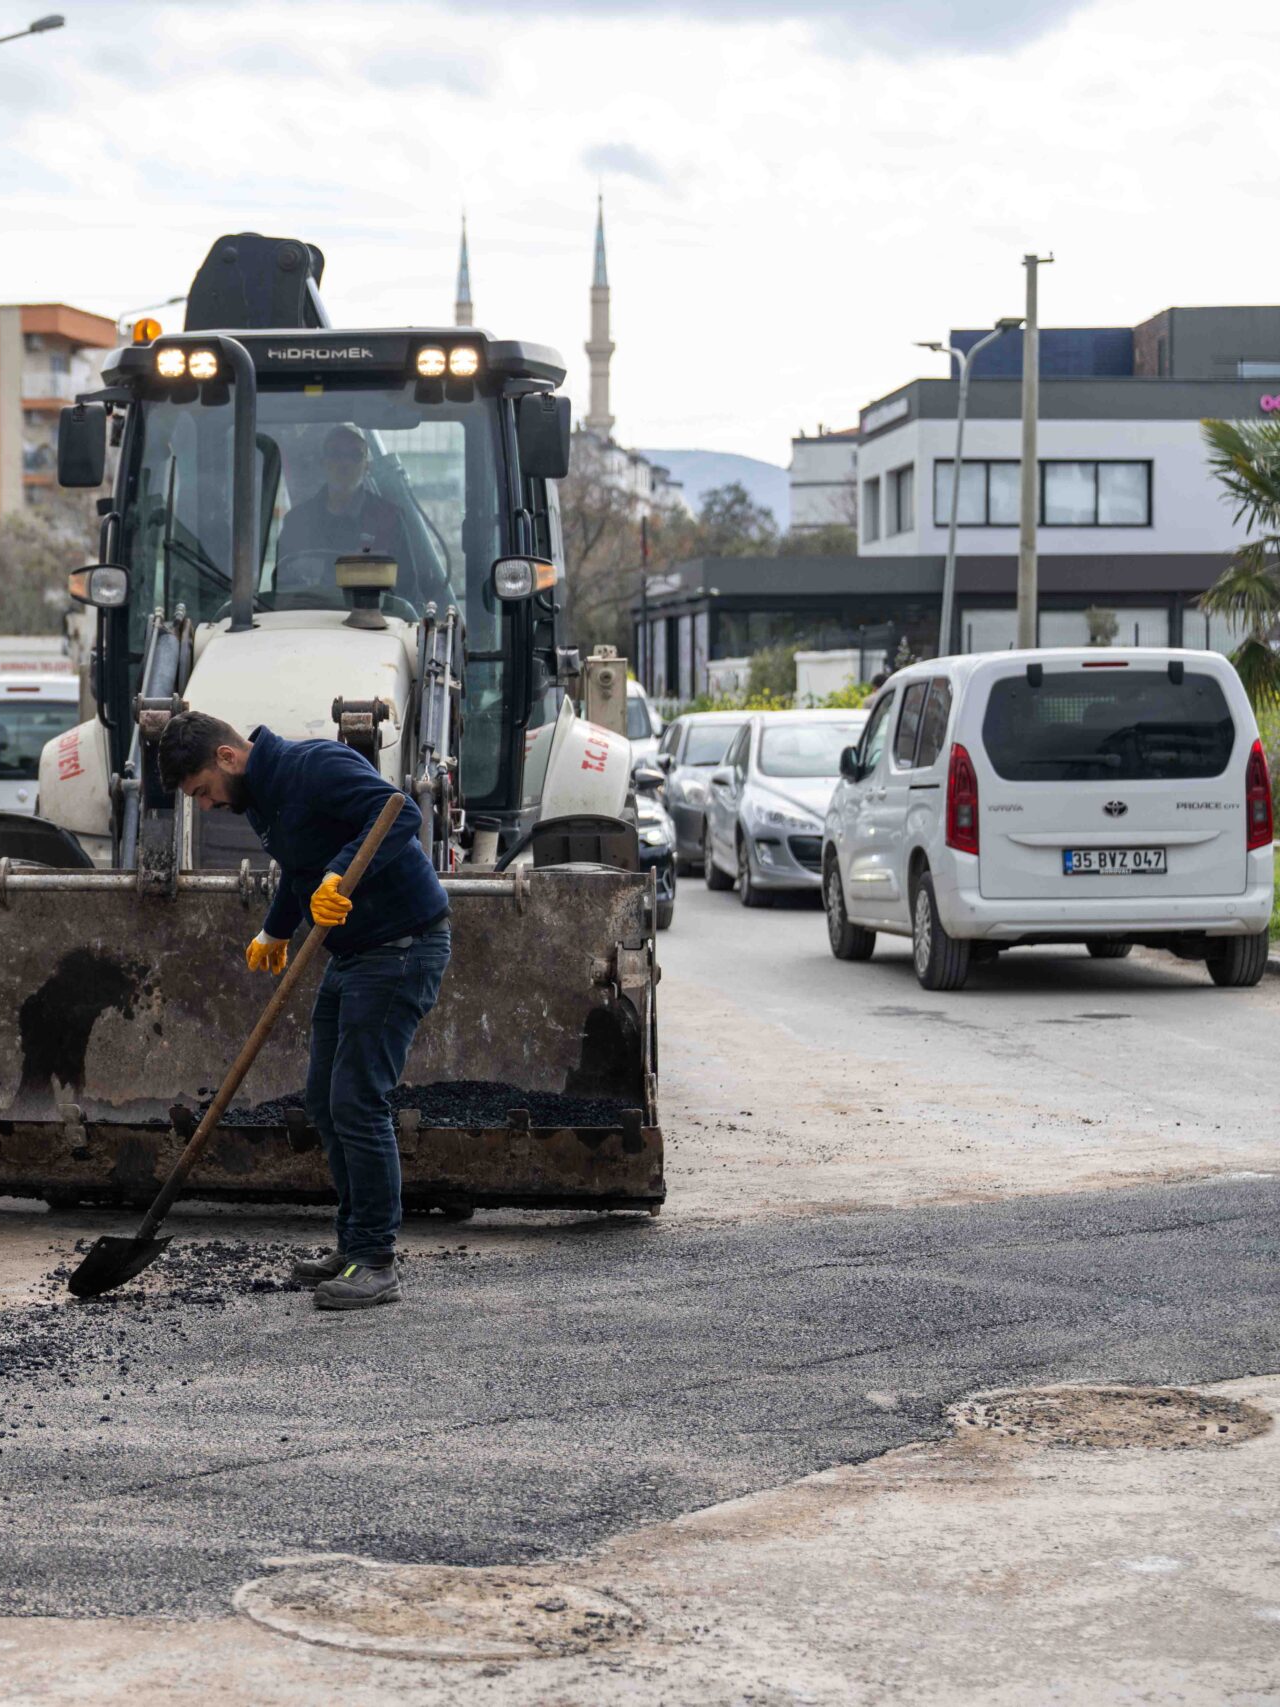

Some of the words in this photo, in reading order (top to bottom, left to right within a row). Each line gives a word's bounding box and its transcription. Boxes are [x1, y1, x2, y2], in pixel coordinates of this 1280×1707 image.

[1073, 851, 1093, 868] 35
[1098, 852, 1128, 868] BVZ
[1133, 851, 1163, 868] 047
